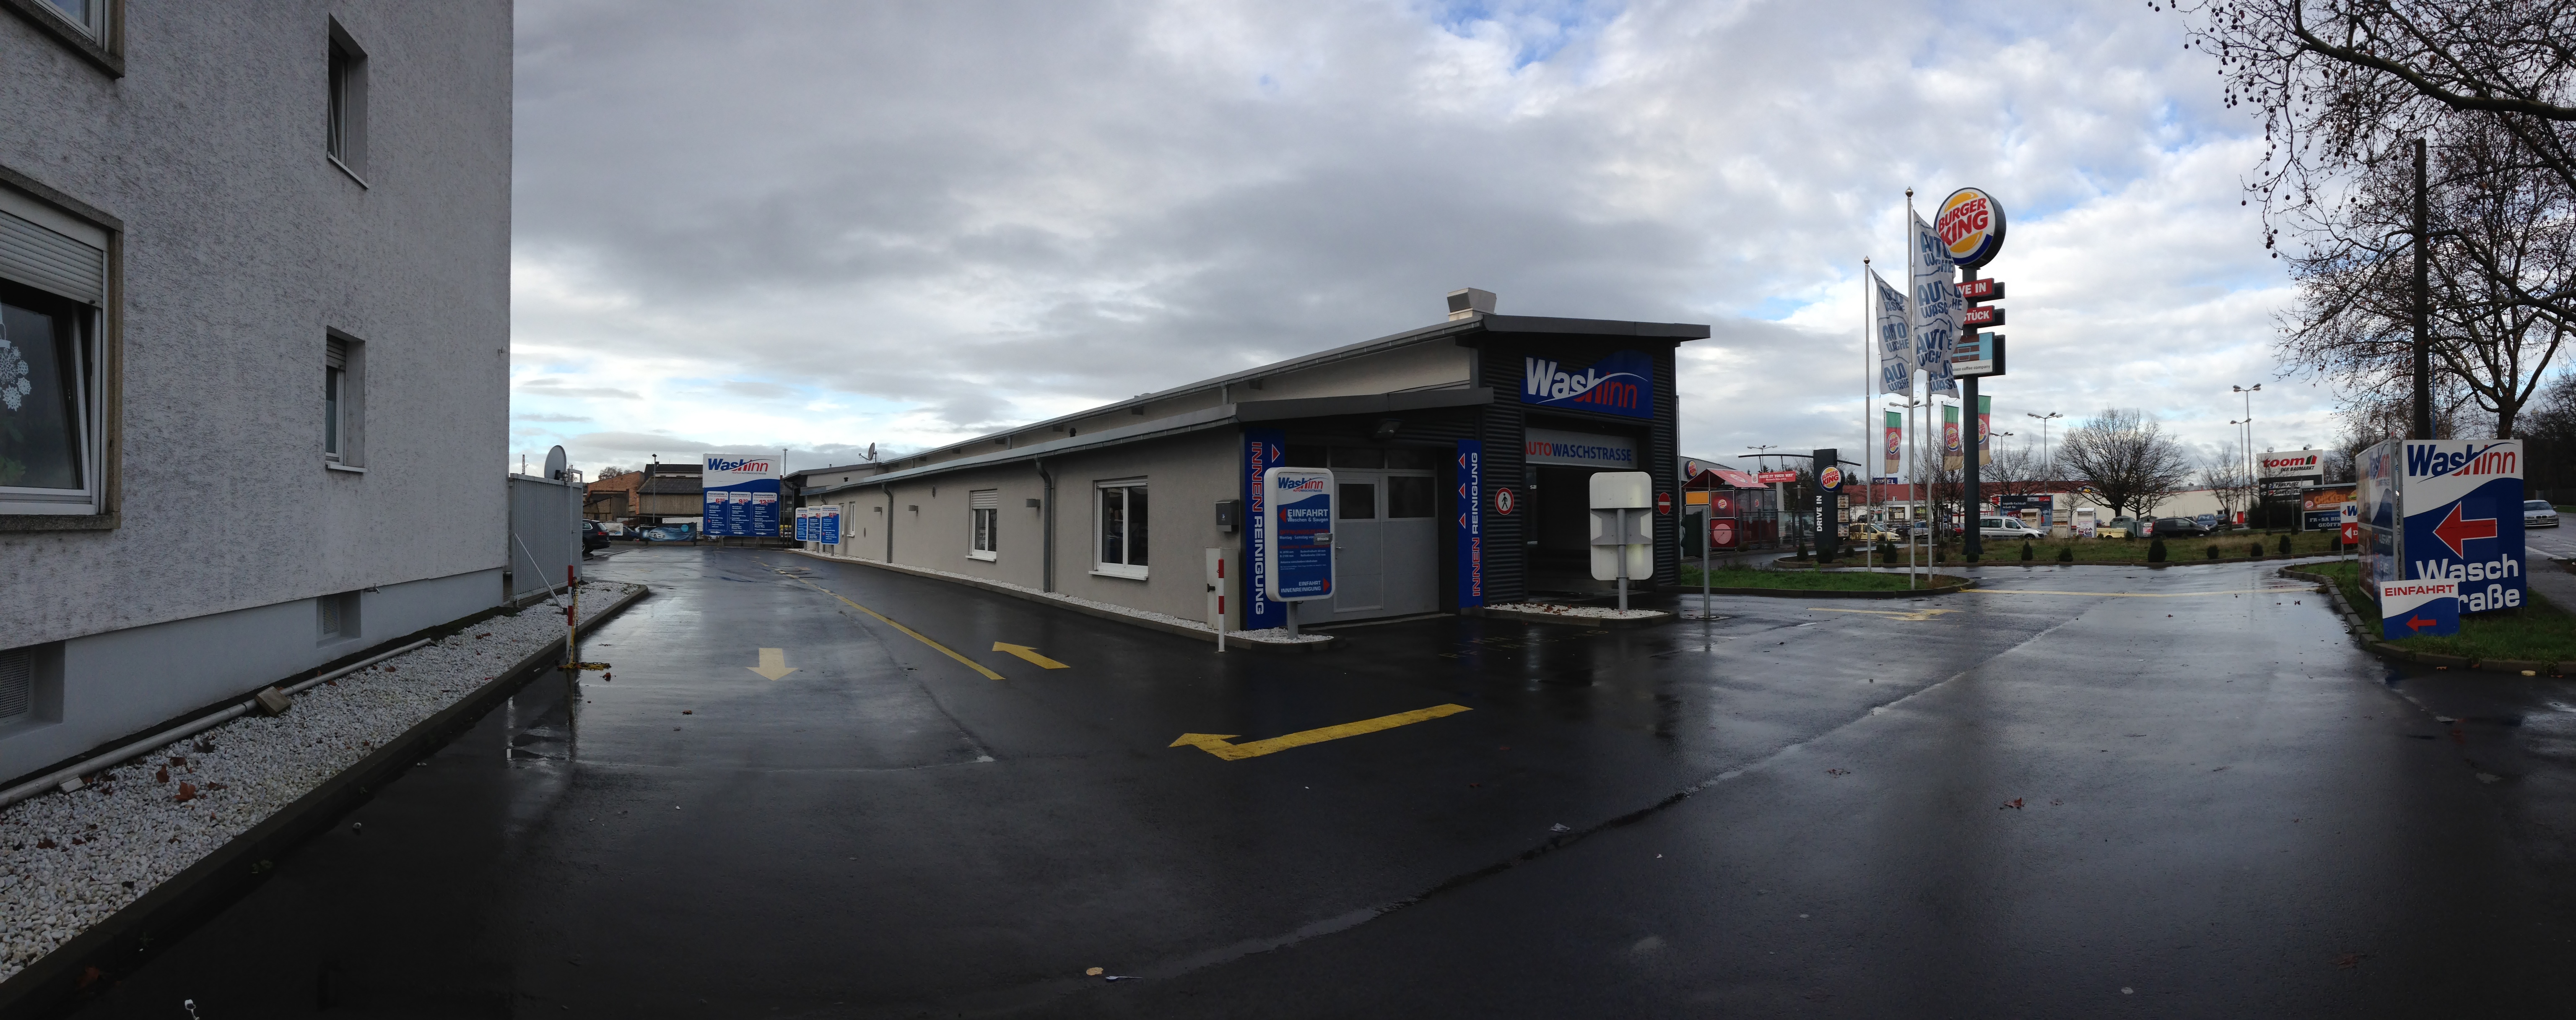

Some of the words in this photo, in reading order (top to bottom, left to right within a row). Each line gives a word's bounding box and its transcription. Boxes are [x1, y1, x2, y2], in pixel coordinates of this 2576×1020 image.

[1939, 198, 1987, 233] BURGER
[1940, 210, 1988, 246] KING
[1975, 282, 1986, 293] IN
[1964, 310, 1989, 322] TÜCK
[1526, 357, 1637, 409] Washinn
[708, 458, 768, 471] Washinn
[2263, 458, 2305, 467] toom
[2407, 445, 2516, 476] Washinn
[1252, 442, 1262, 512] INNEN
[1822, 470, 1838, 480] BURGER
[1823, 475, 1839, 487] KING
[1278, 477, 1323, 489] Washinn
[1816, 496, 1822, 504] IN
[2314, 494, 2346, 504] CHICKEN
[1254, 516, 1264, 614] REINIGUNG
[2416, 554, 2519, 583] Wasch
[2385, 585, 2454, 596] EINFAHRT
[2459, 584, 2520, 613] raße
